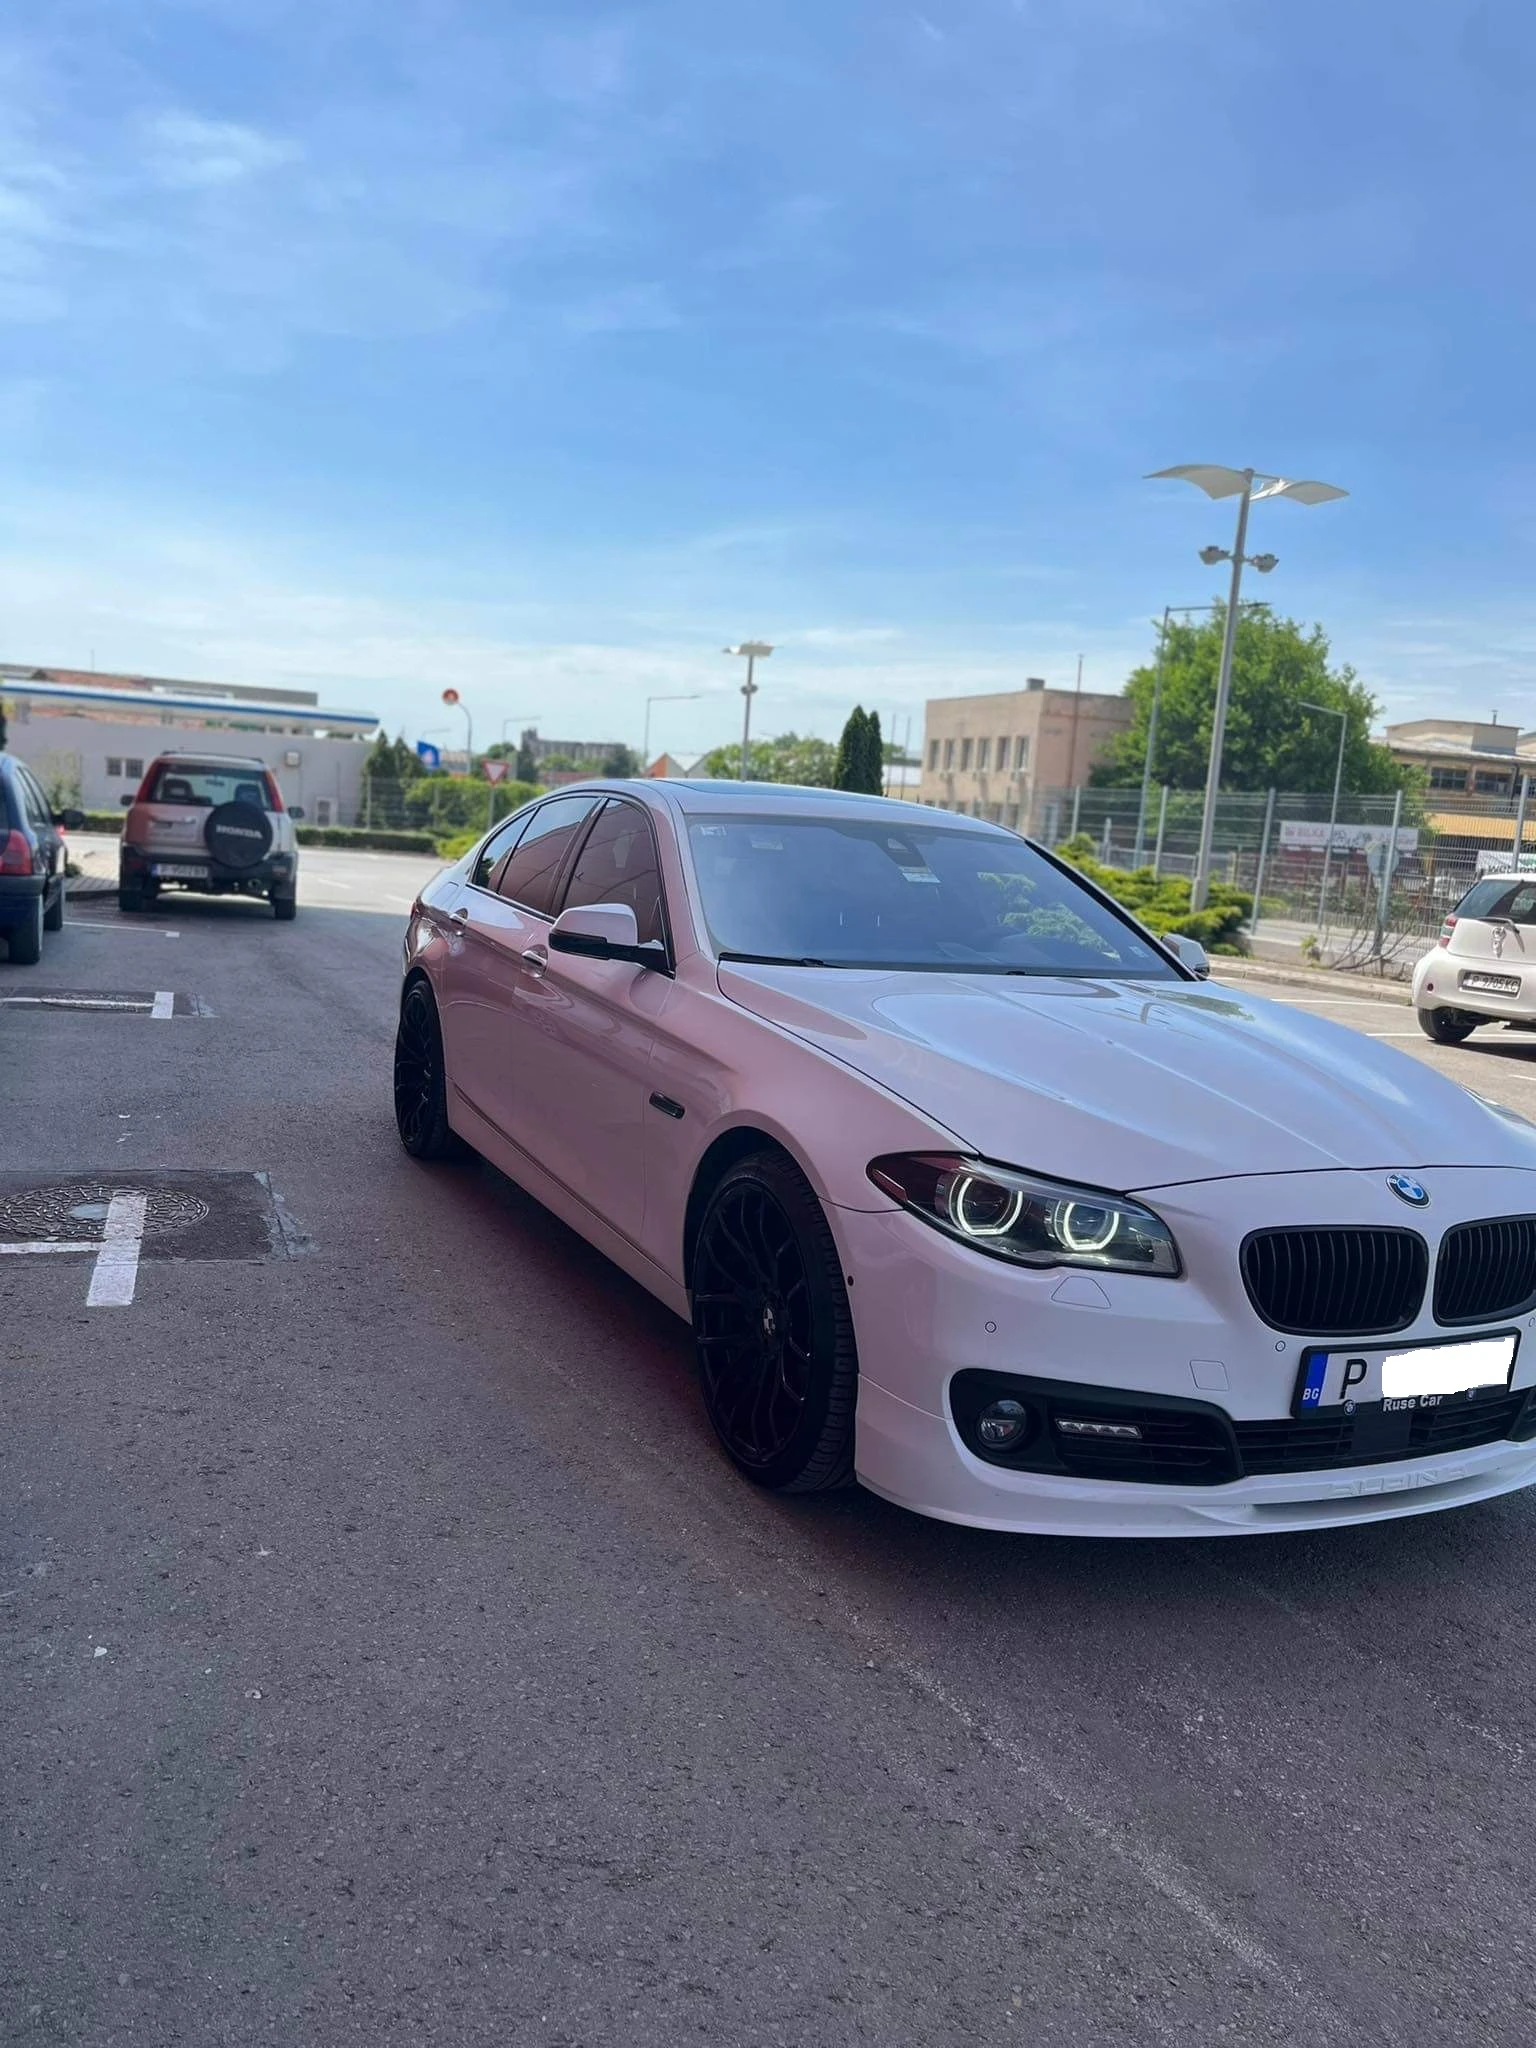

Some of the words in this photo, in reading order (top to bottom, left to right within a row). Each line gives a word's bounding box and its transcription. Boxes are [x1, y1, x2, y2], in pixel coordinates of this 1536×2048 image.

[216, 825, 263, 839] HONDA
[1339, 1358, 1368, 1399] P
[1303, 1387, 1319, 1400] BG
[1382, 1396, 1416, 1411] Ruse
[1420, 1394, 1442, 1407] Car
